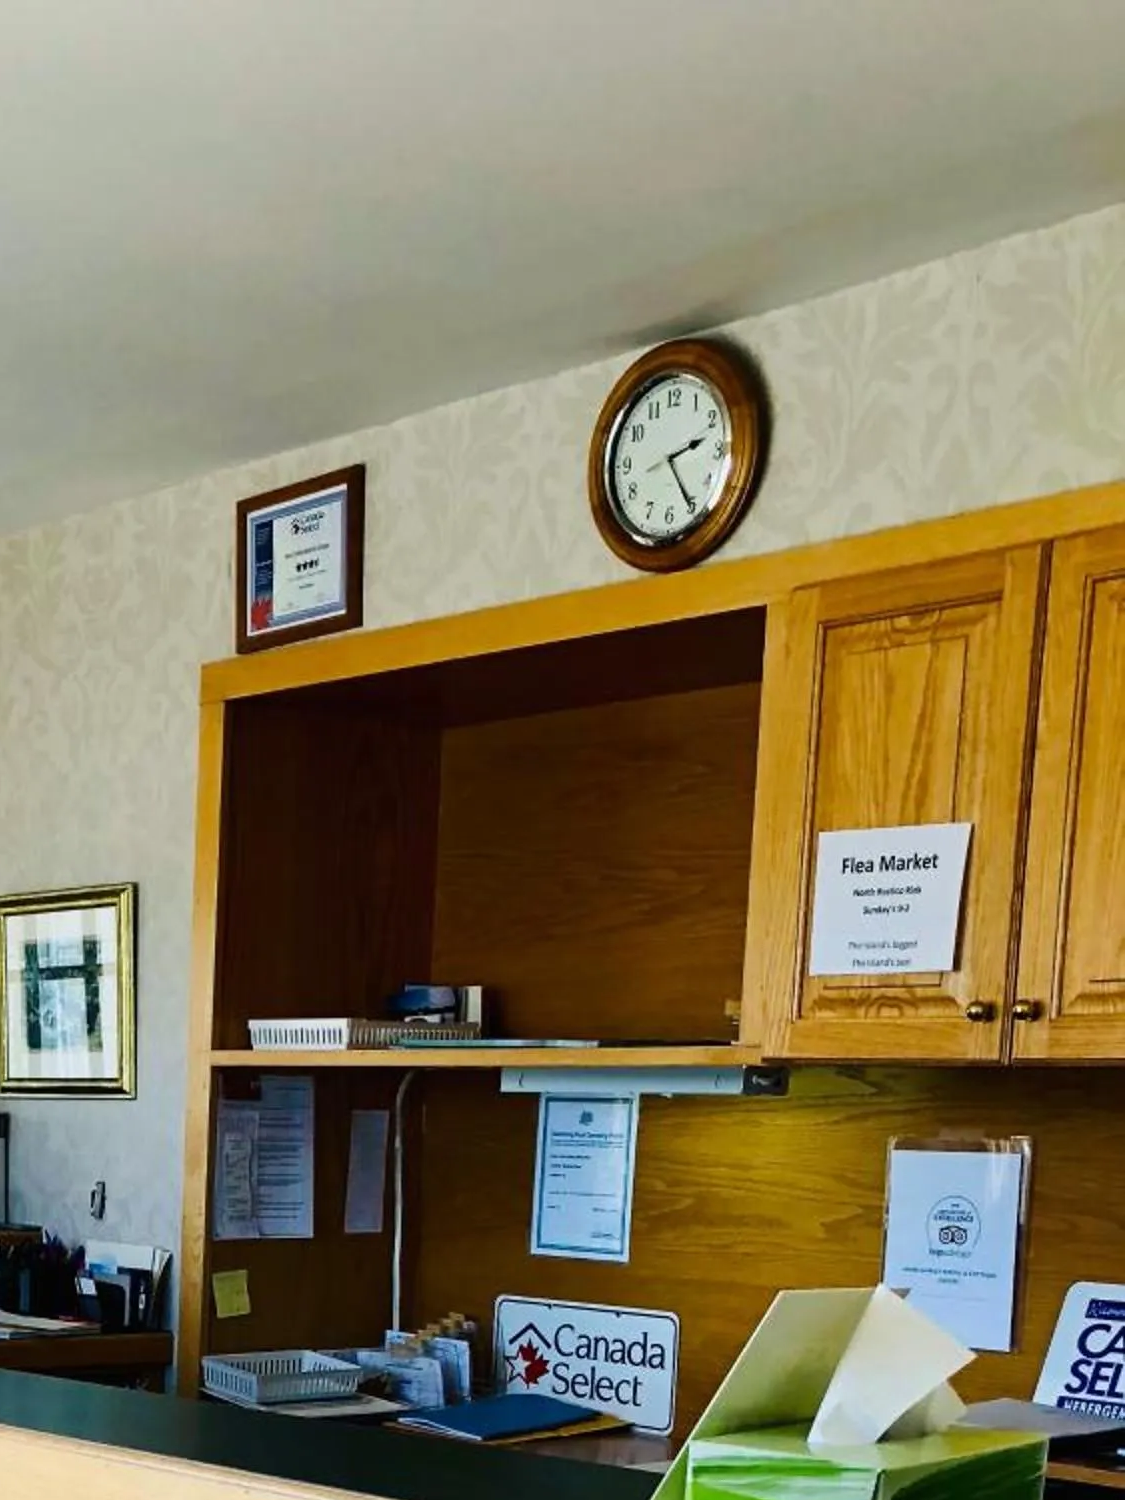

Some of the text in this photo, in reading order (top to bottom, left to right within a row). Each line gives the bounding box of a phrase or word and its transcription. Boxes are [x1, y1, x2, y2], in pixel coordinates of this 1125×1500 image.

[667, 388, 682, 408] 12
[694, 392, 698, 412] 1
[648, 400, 660, 420] 11
[708, 409, 717, 428] 2
[631, 423, 645, 443] 10
[713, 440, 726, 461] 3
[622, 456, 632, 475] 9
[628, 482, 638, 500] 8
[646, 500, 654, 520] 7
[664, 506, 675, 524] 6
[686, 496, 698, 514] 5
[842, 852, 939, 874] Flea Market
[554, 1323, 666, 1370] Canada
[552, 1362, 643, 1407] Select
